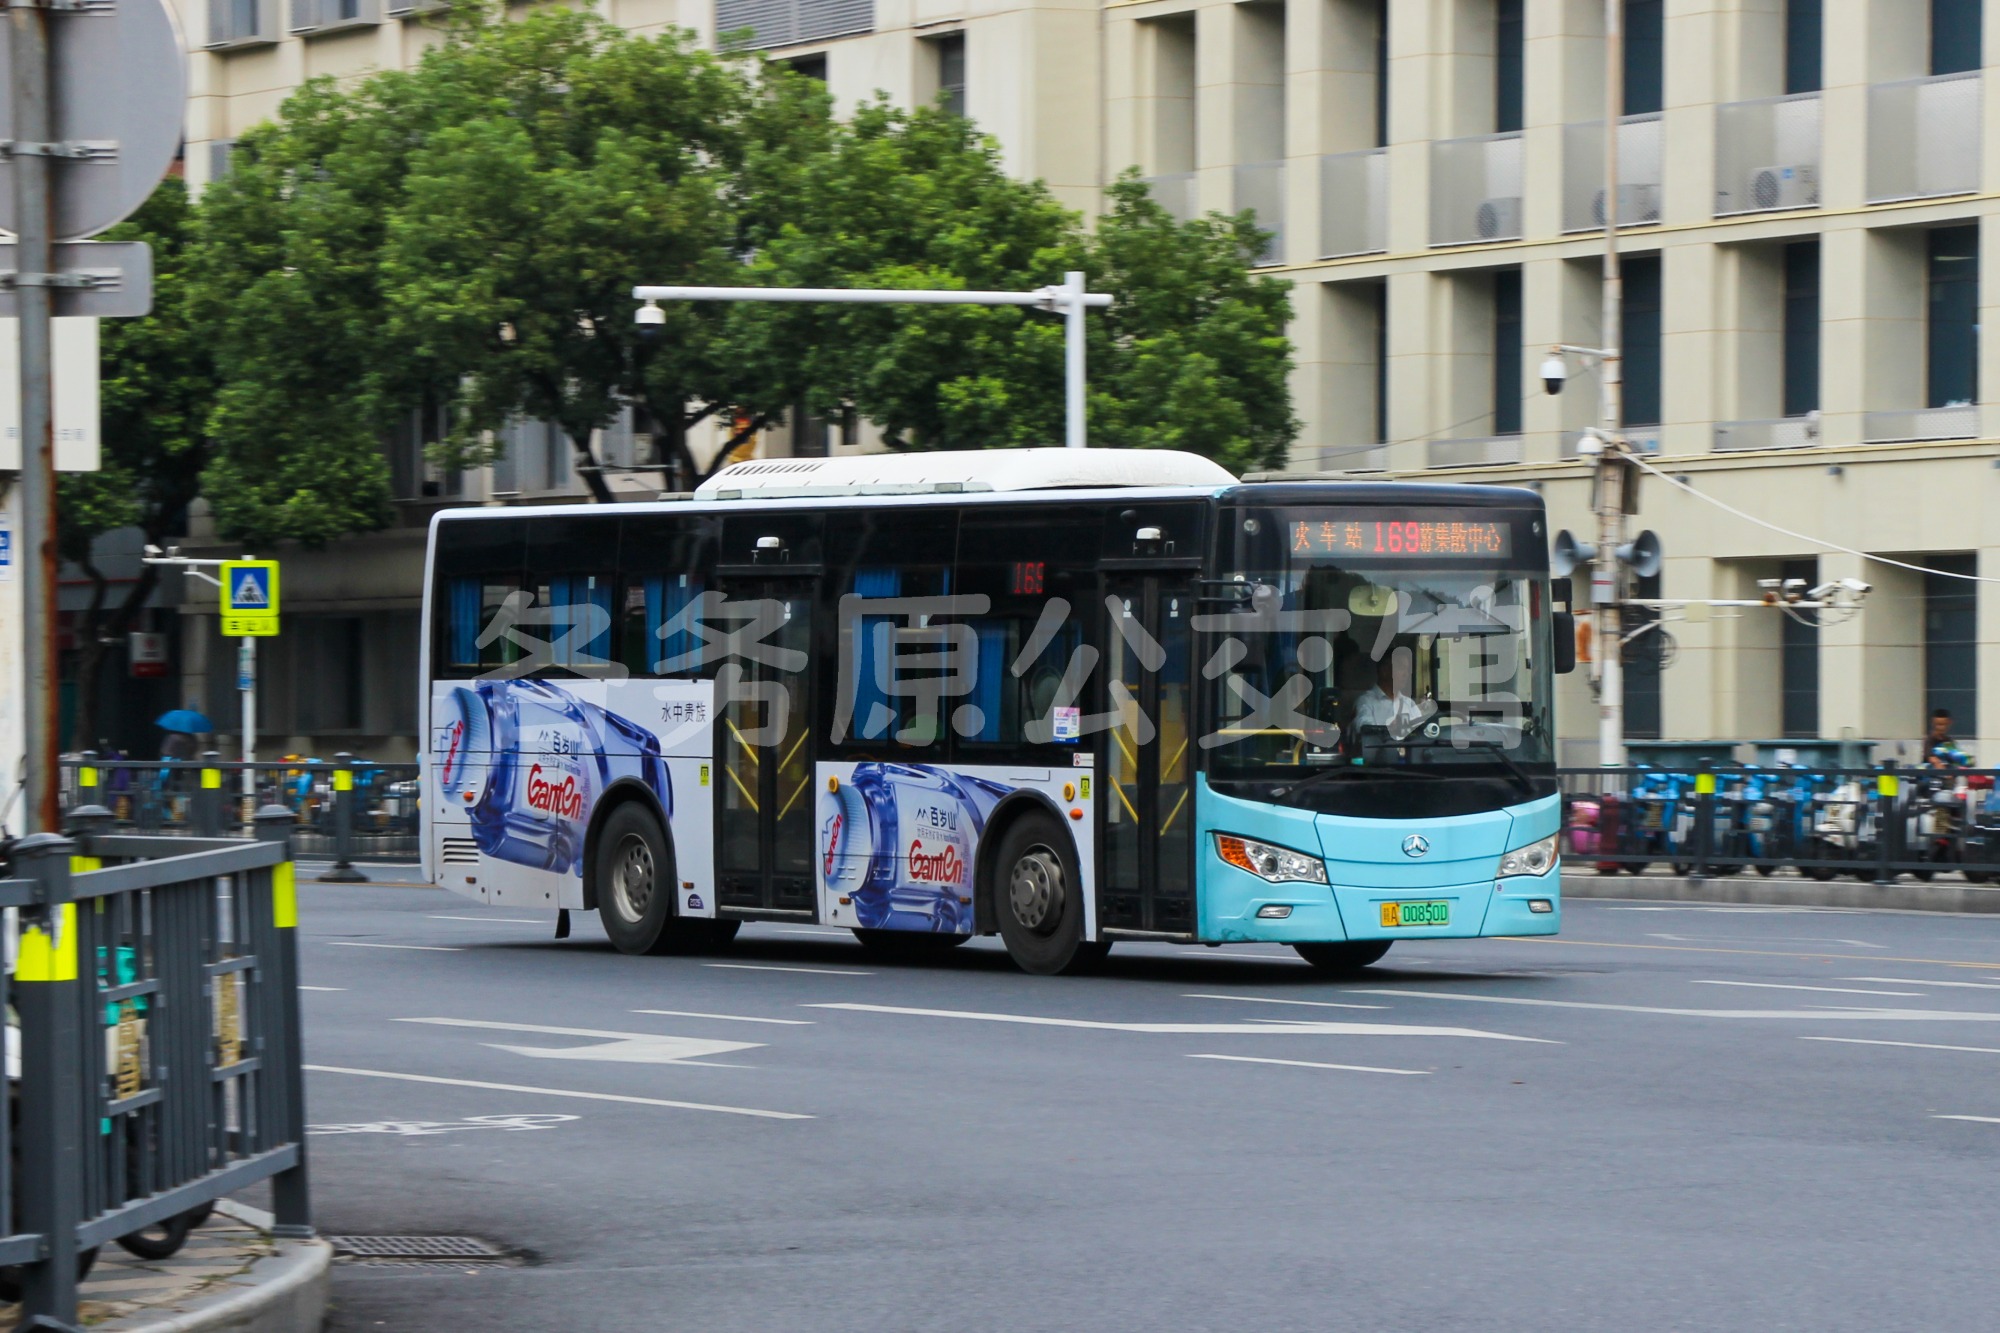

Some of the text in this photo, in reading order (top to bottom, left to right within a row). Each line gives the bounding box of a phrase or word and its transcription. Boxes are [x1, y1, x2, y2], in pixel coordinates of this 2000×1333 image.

[1294, 521, 1362, 551] 火车站
[1374, 521, 1420, 552] 169
[661, 702, 706, 722] 水中贵族
[527, 763, 582, 820] Ganten
[930, 806, 957, 831] 百岁山
[909, 839, 963, 884] Ganten
